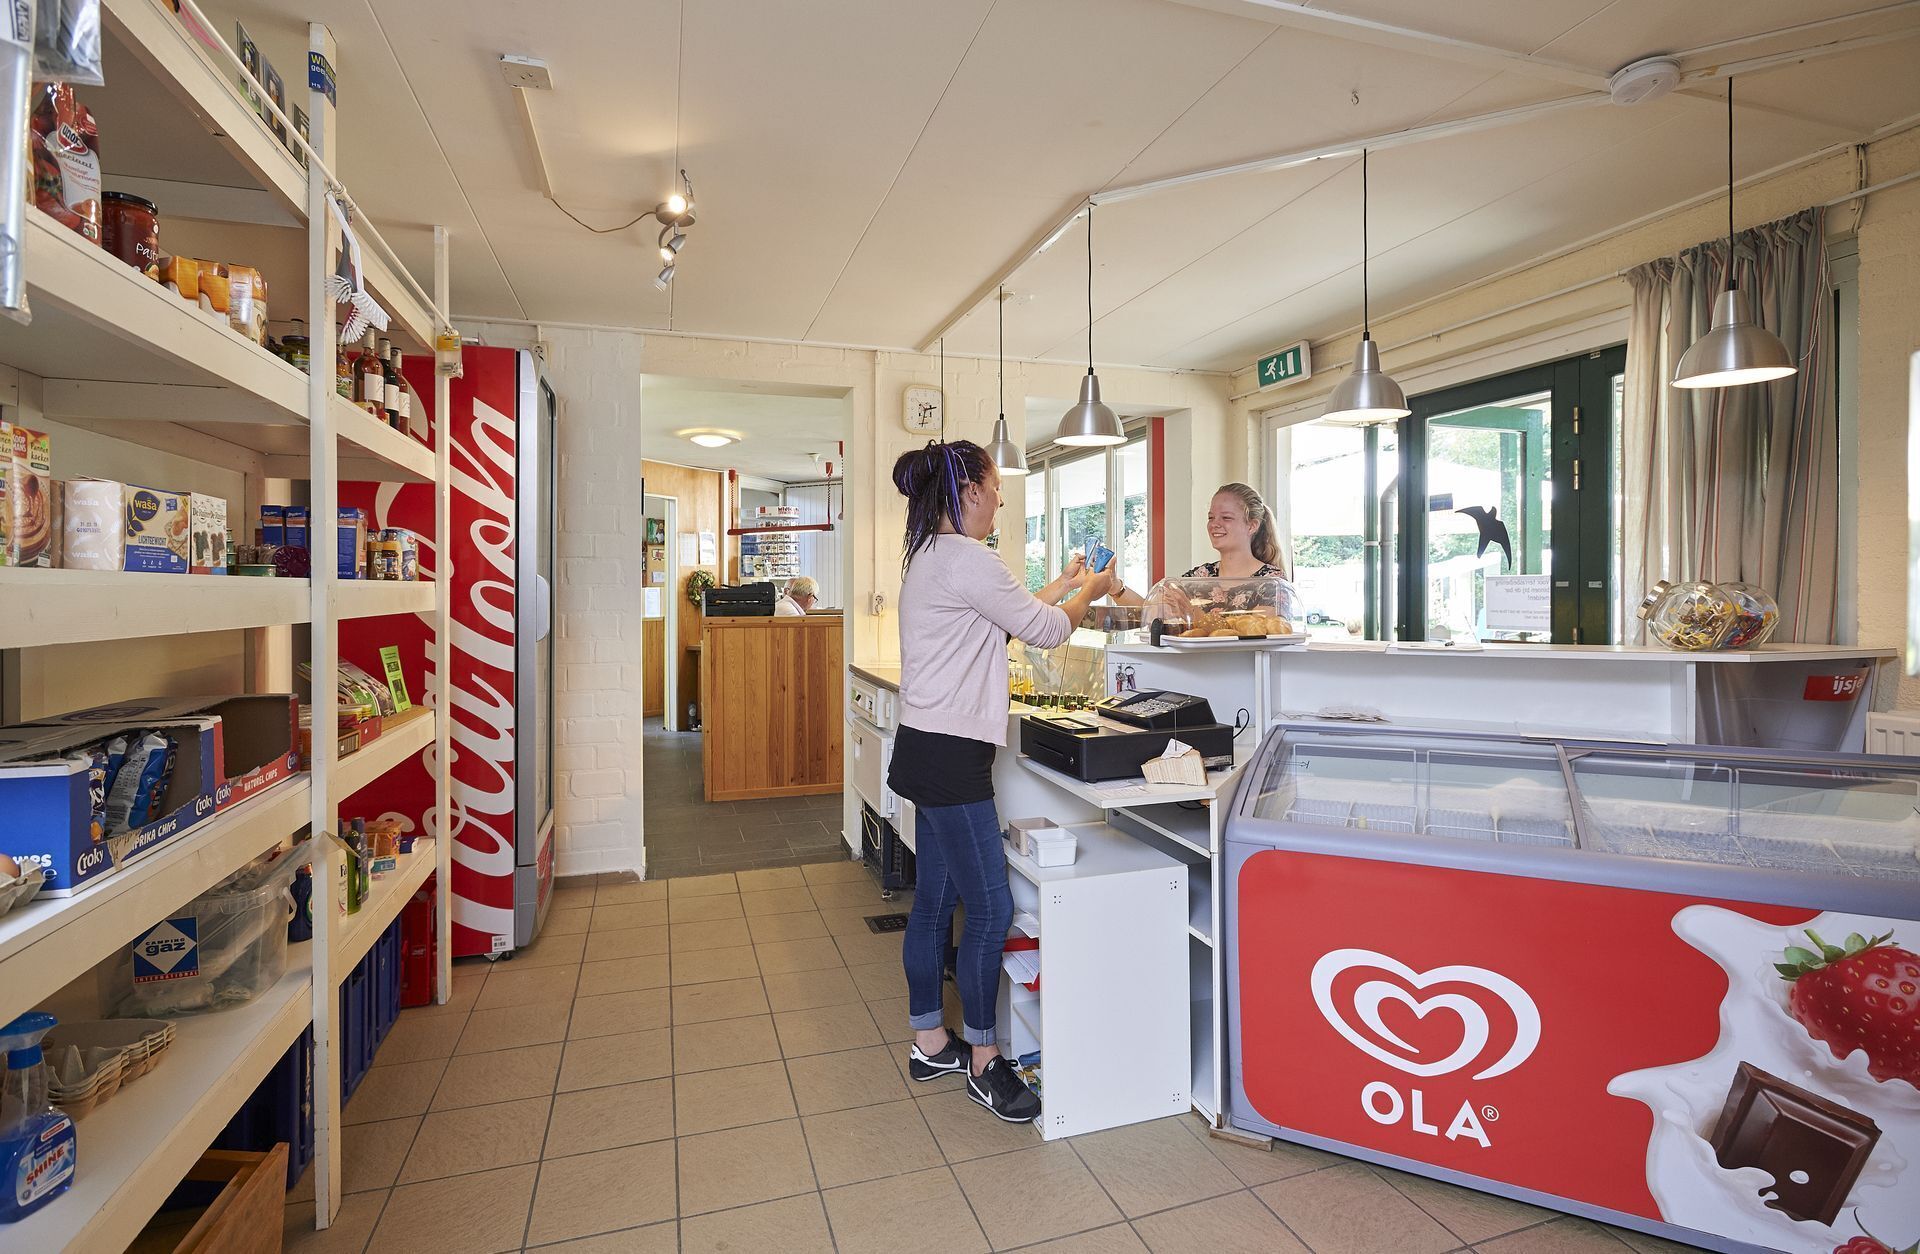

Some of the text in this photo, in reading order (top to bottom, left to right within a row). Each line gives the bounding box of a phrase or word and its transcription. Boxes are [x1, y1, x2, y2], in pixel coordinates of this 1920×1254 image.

[134, 499, 158, 511] wasa
[77, 847, 104, 876] Croky
[145, 937, 185, 946] CAMPING
[145, 942, 185, 957] gaz
[26, 1145, 65, 1186] SHINE
